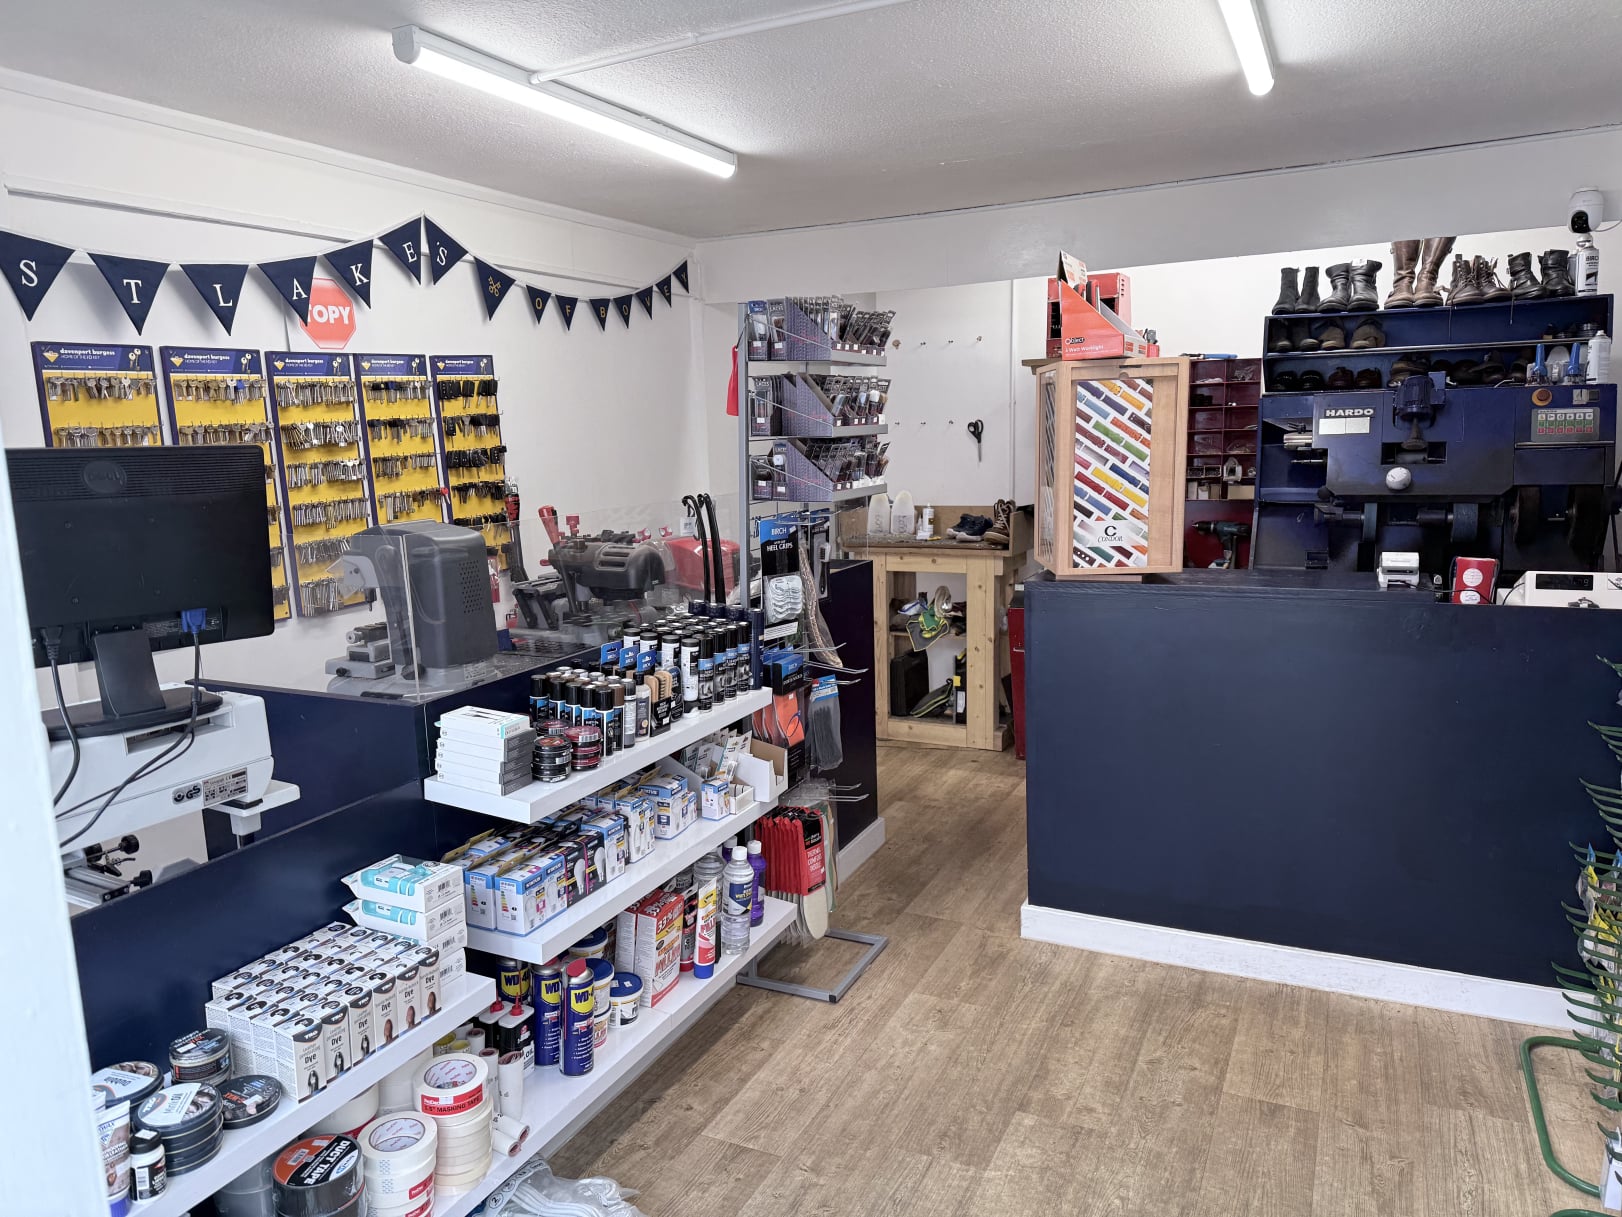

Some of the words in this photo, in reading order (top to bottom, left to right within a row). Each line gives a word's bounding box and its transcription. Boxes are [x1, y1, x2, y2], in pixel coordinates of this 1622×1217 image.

[1325, 408, 1374, 417] HARDO
[771, 527, 787, 536] BIRCH
[437, 1103, 466, 1113] MASKING
[467, 1096, 480, 1105] TAPE
[326, 1140, 351, 1163] DUCT
[304, 1163, 330, 1185] TAPE
